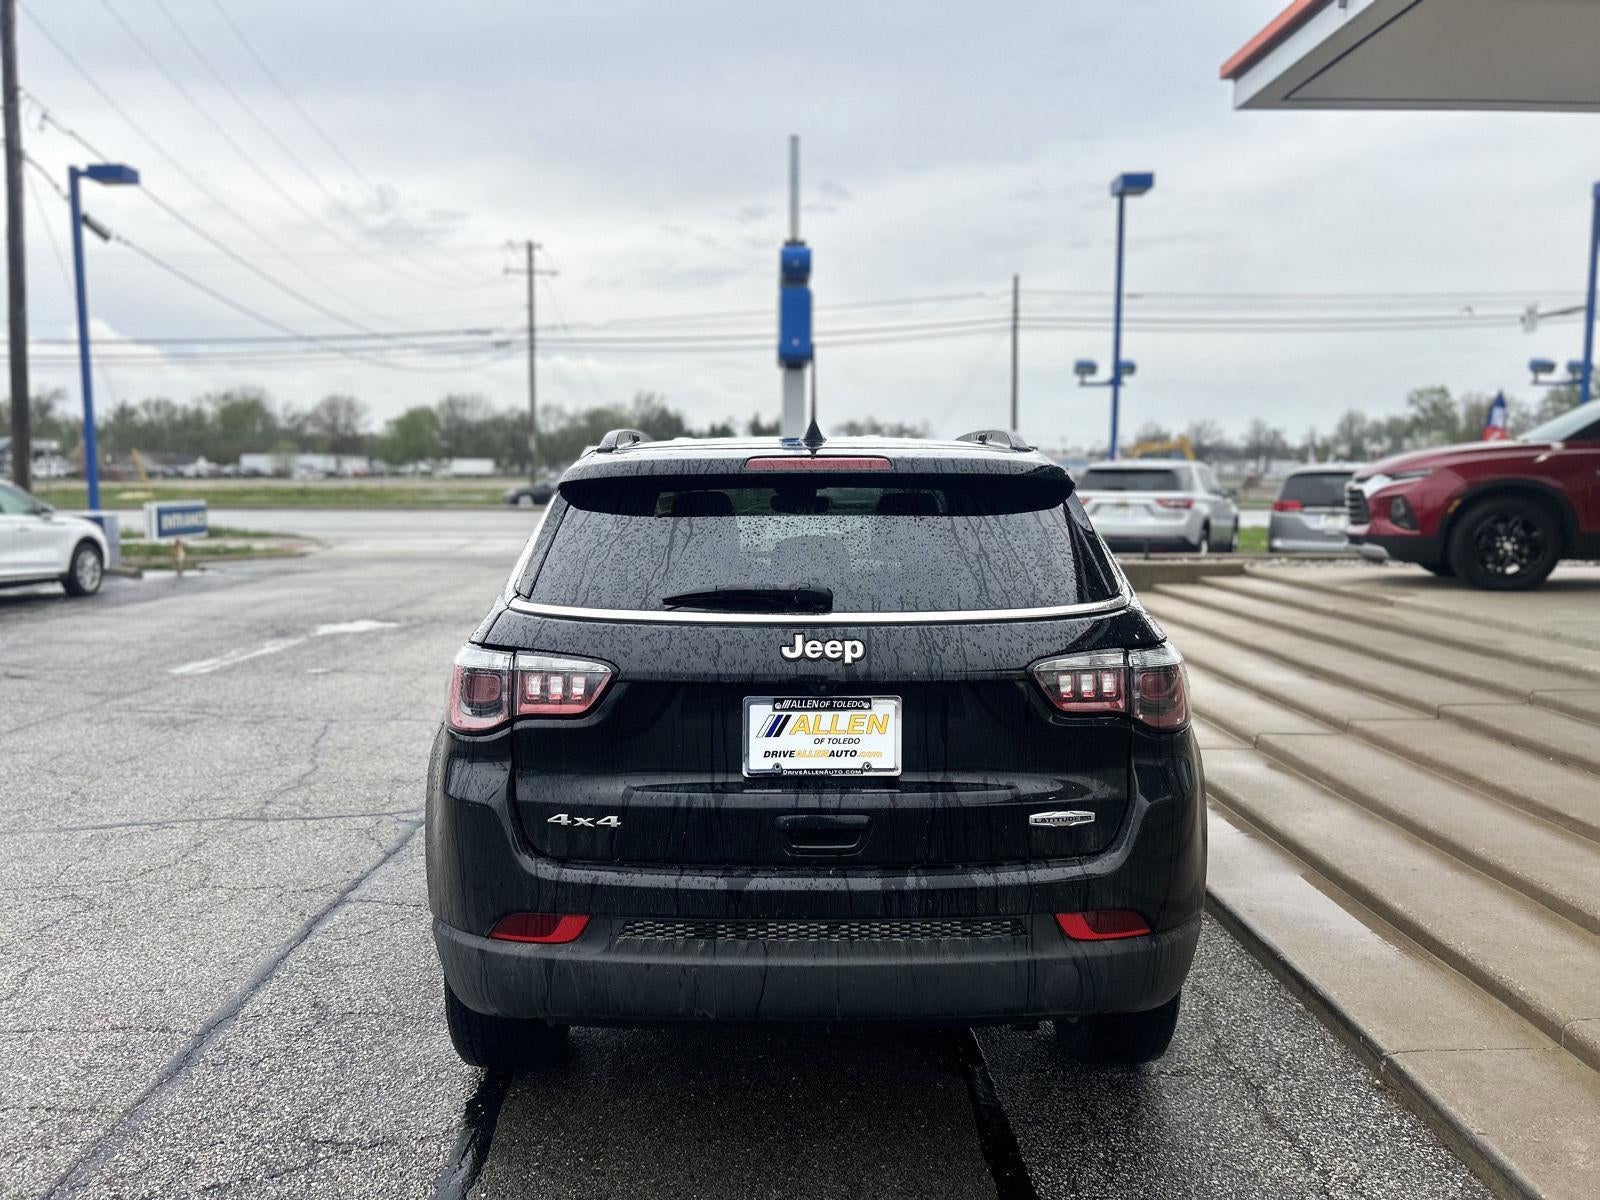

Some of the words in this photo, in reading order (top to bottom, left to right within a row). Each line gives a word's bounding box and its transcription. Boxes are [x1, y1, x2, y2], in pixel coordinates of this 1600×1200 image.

[780, 634, 866, 664] Jeep
[790, 700, 819, 709] ALLEN
[819, 700, 830, 708] OF
[832, 700, 864, 708] TOLEDO
[789, 714, 890, 735] ALLEN
[827, 737, 861, 745] TOLEDO
[547, 813, 622, 828] 4x4
[1034, 815, 1079, 824] LATITUDE
